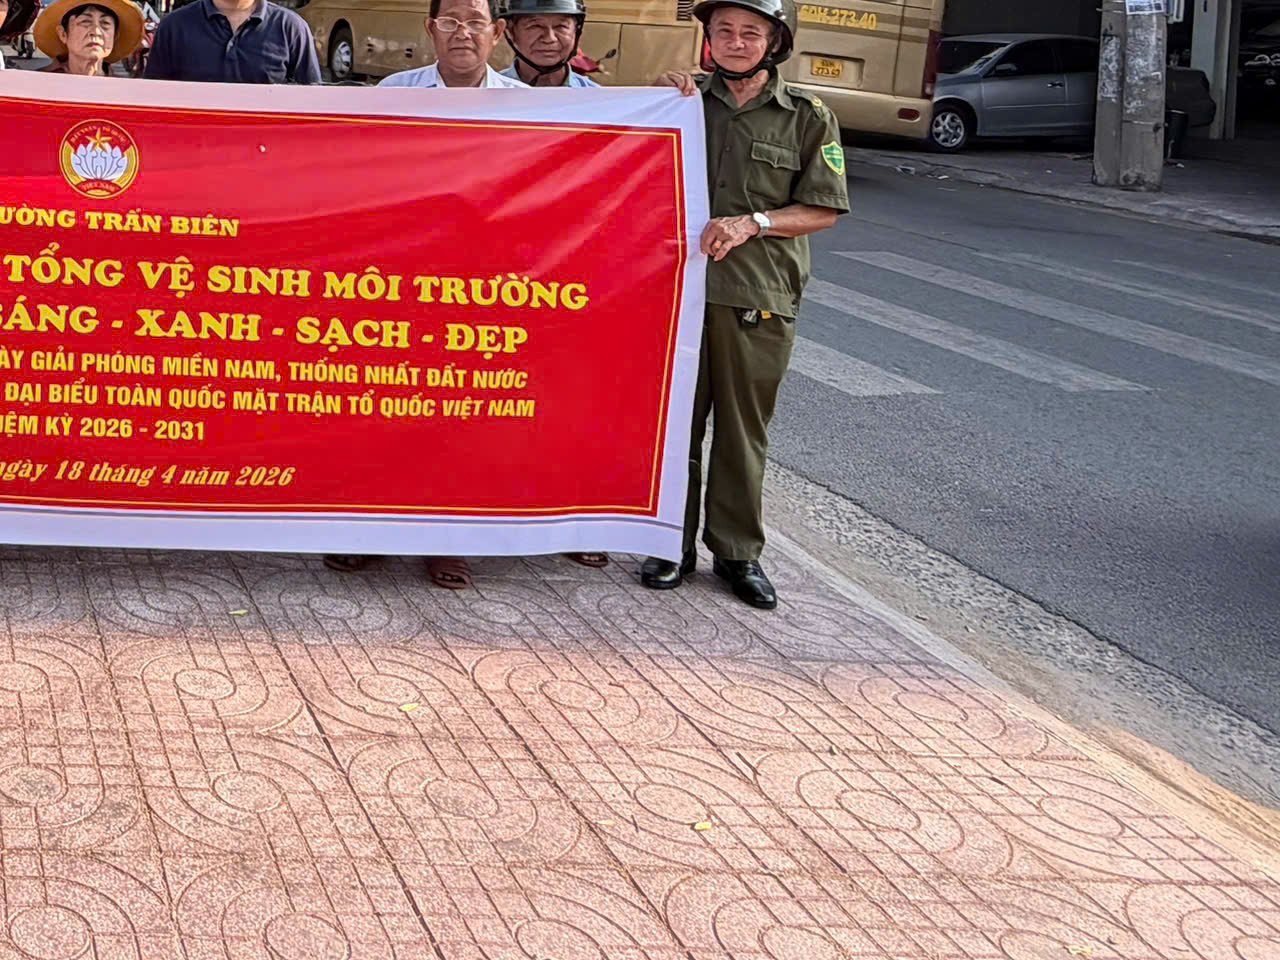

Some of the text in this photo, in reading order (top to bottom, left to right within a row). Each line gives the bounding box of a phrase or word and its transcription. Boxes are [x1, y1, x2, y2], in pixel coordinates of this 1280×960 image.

[85, 208, 162, 233] TRẤN
[170, 214, 240, 237] BIÊN
[3, 242, 125, 287] TỔNG
[137, 256, 195, 298] VỆ
[207, 265, 312, 297] SINH
[322, 266, 403, 301] MÔI
[413, 272, 589, 310] TRƯỜNG
[134, 309, 262, 341] XANH
[296, 316, 411, 352] SẠCH
[444, 323, 528, 360] ĐẸP
[31, 345, 74, 371] GIẢI
[81, 350, 155, 375] PHÓNG
[162, 352, 218, 377] MIỀN
[225, 359, 281, 382] NAM,
[288, 357, 358, 383] THỐNG
[365, 361, 421, 386] NHẤT
[426, 363, 467, 388] ĐẤT
[472, 368, 528, 389] NƯỚC
[4, 382, 41, 406] ĐẠI
[48, 377, 98, 405] BIỂU
[105, 383, 161, 407] TOÀN
[168, 385, 226, 410] QUỐC
[233, 388, 279, 411] MẶT
[285, 391, 341, 414] TRẬN
[347, 389, 375, 416] TỔ
[380, 392, 436, 418] QUỐC
[442, 396, 484, 419] VIỆT
[487, 400, 535, 420] NAM
[45, 416, 73, 436] KỲ
[80, 417, 133, 438] 2026
[154, 420, 204, 440] 2031
[55, 460, 85, 480] 18
[89, 462, 157, 487] tháng
[161, 465, 177, 484] 4
[179, 467, 230, 485] năm
[235, 466, 296, 486] 2026
